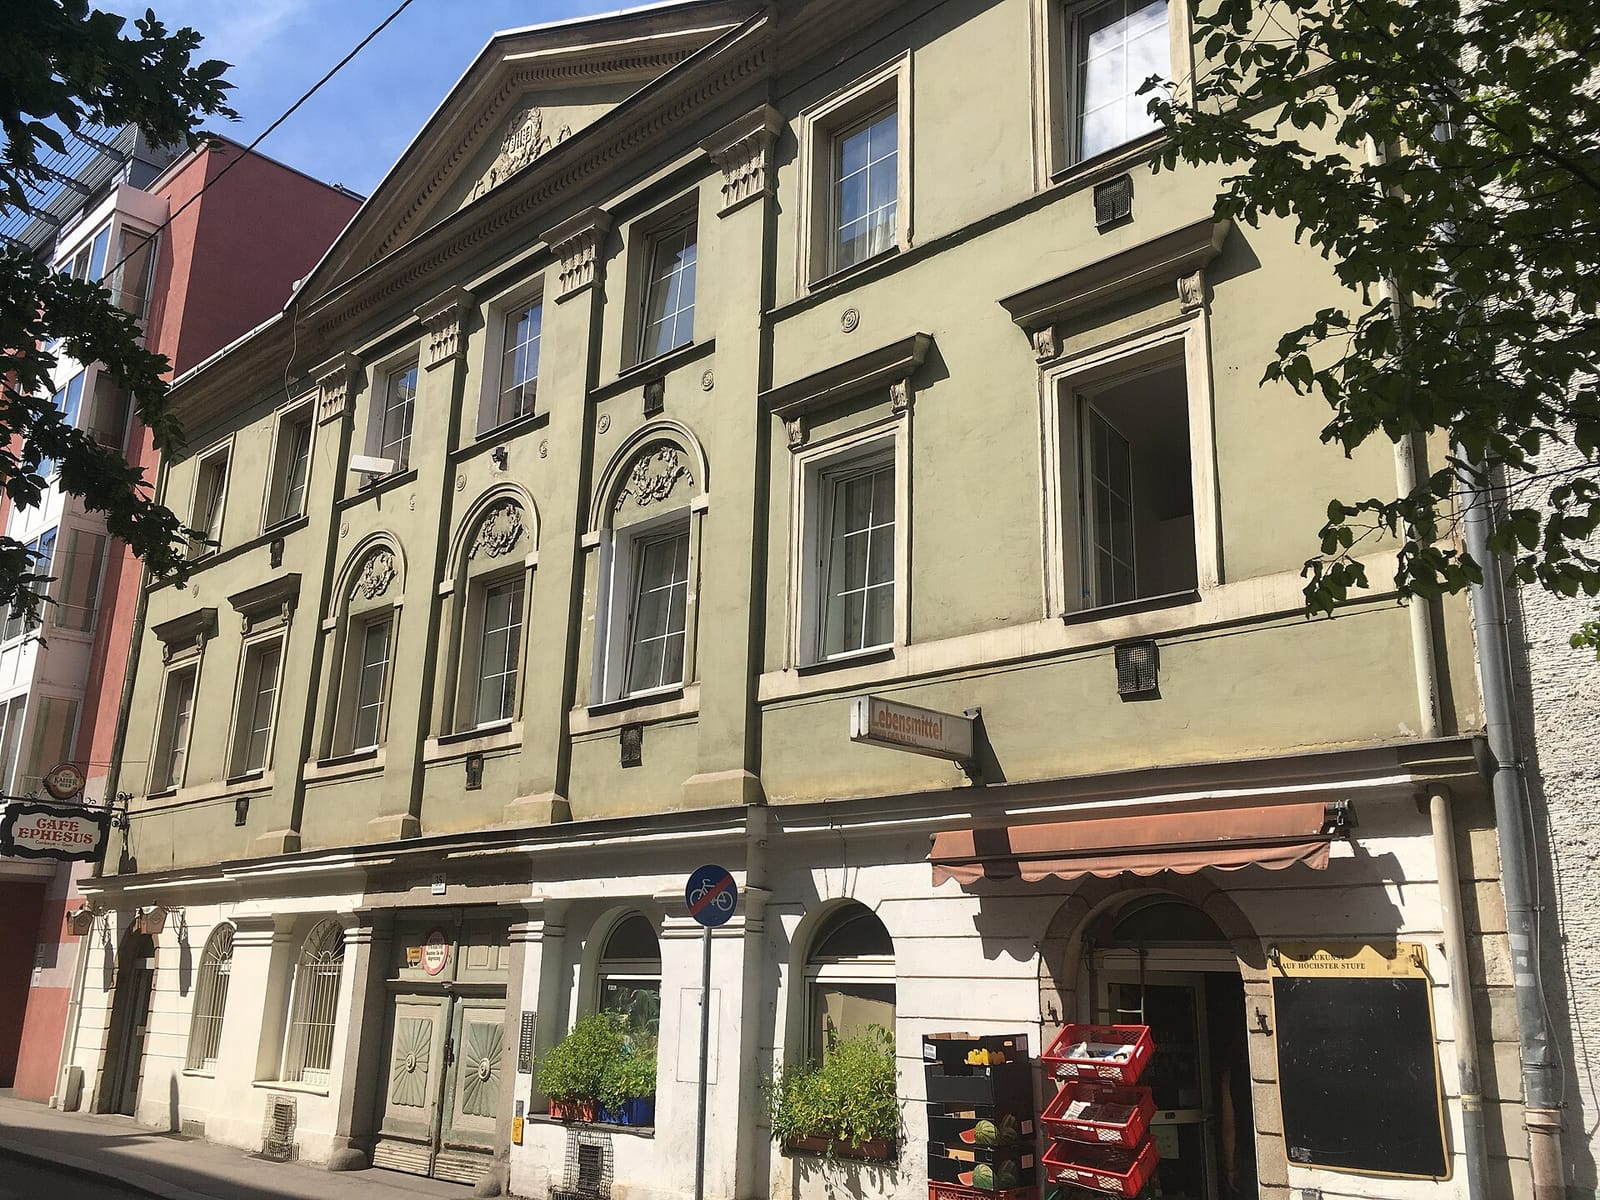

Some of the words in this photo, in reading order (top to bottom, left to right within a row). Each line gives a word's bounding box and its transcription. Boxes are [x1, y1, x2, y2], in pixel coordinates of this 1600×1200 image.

[871, 703, 943, 740] Lebensmittel
[36, 818, 79, 831] CAFE
[17, 827, 93, 844] EPHESUS
[1282, 962, 1295, 970] AUF
[1298, 961, 1339, 970] HÖCHSTER
[1341, 962, 1366, 970] STUFE
